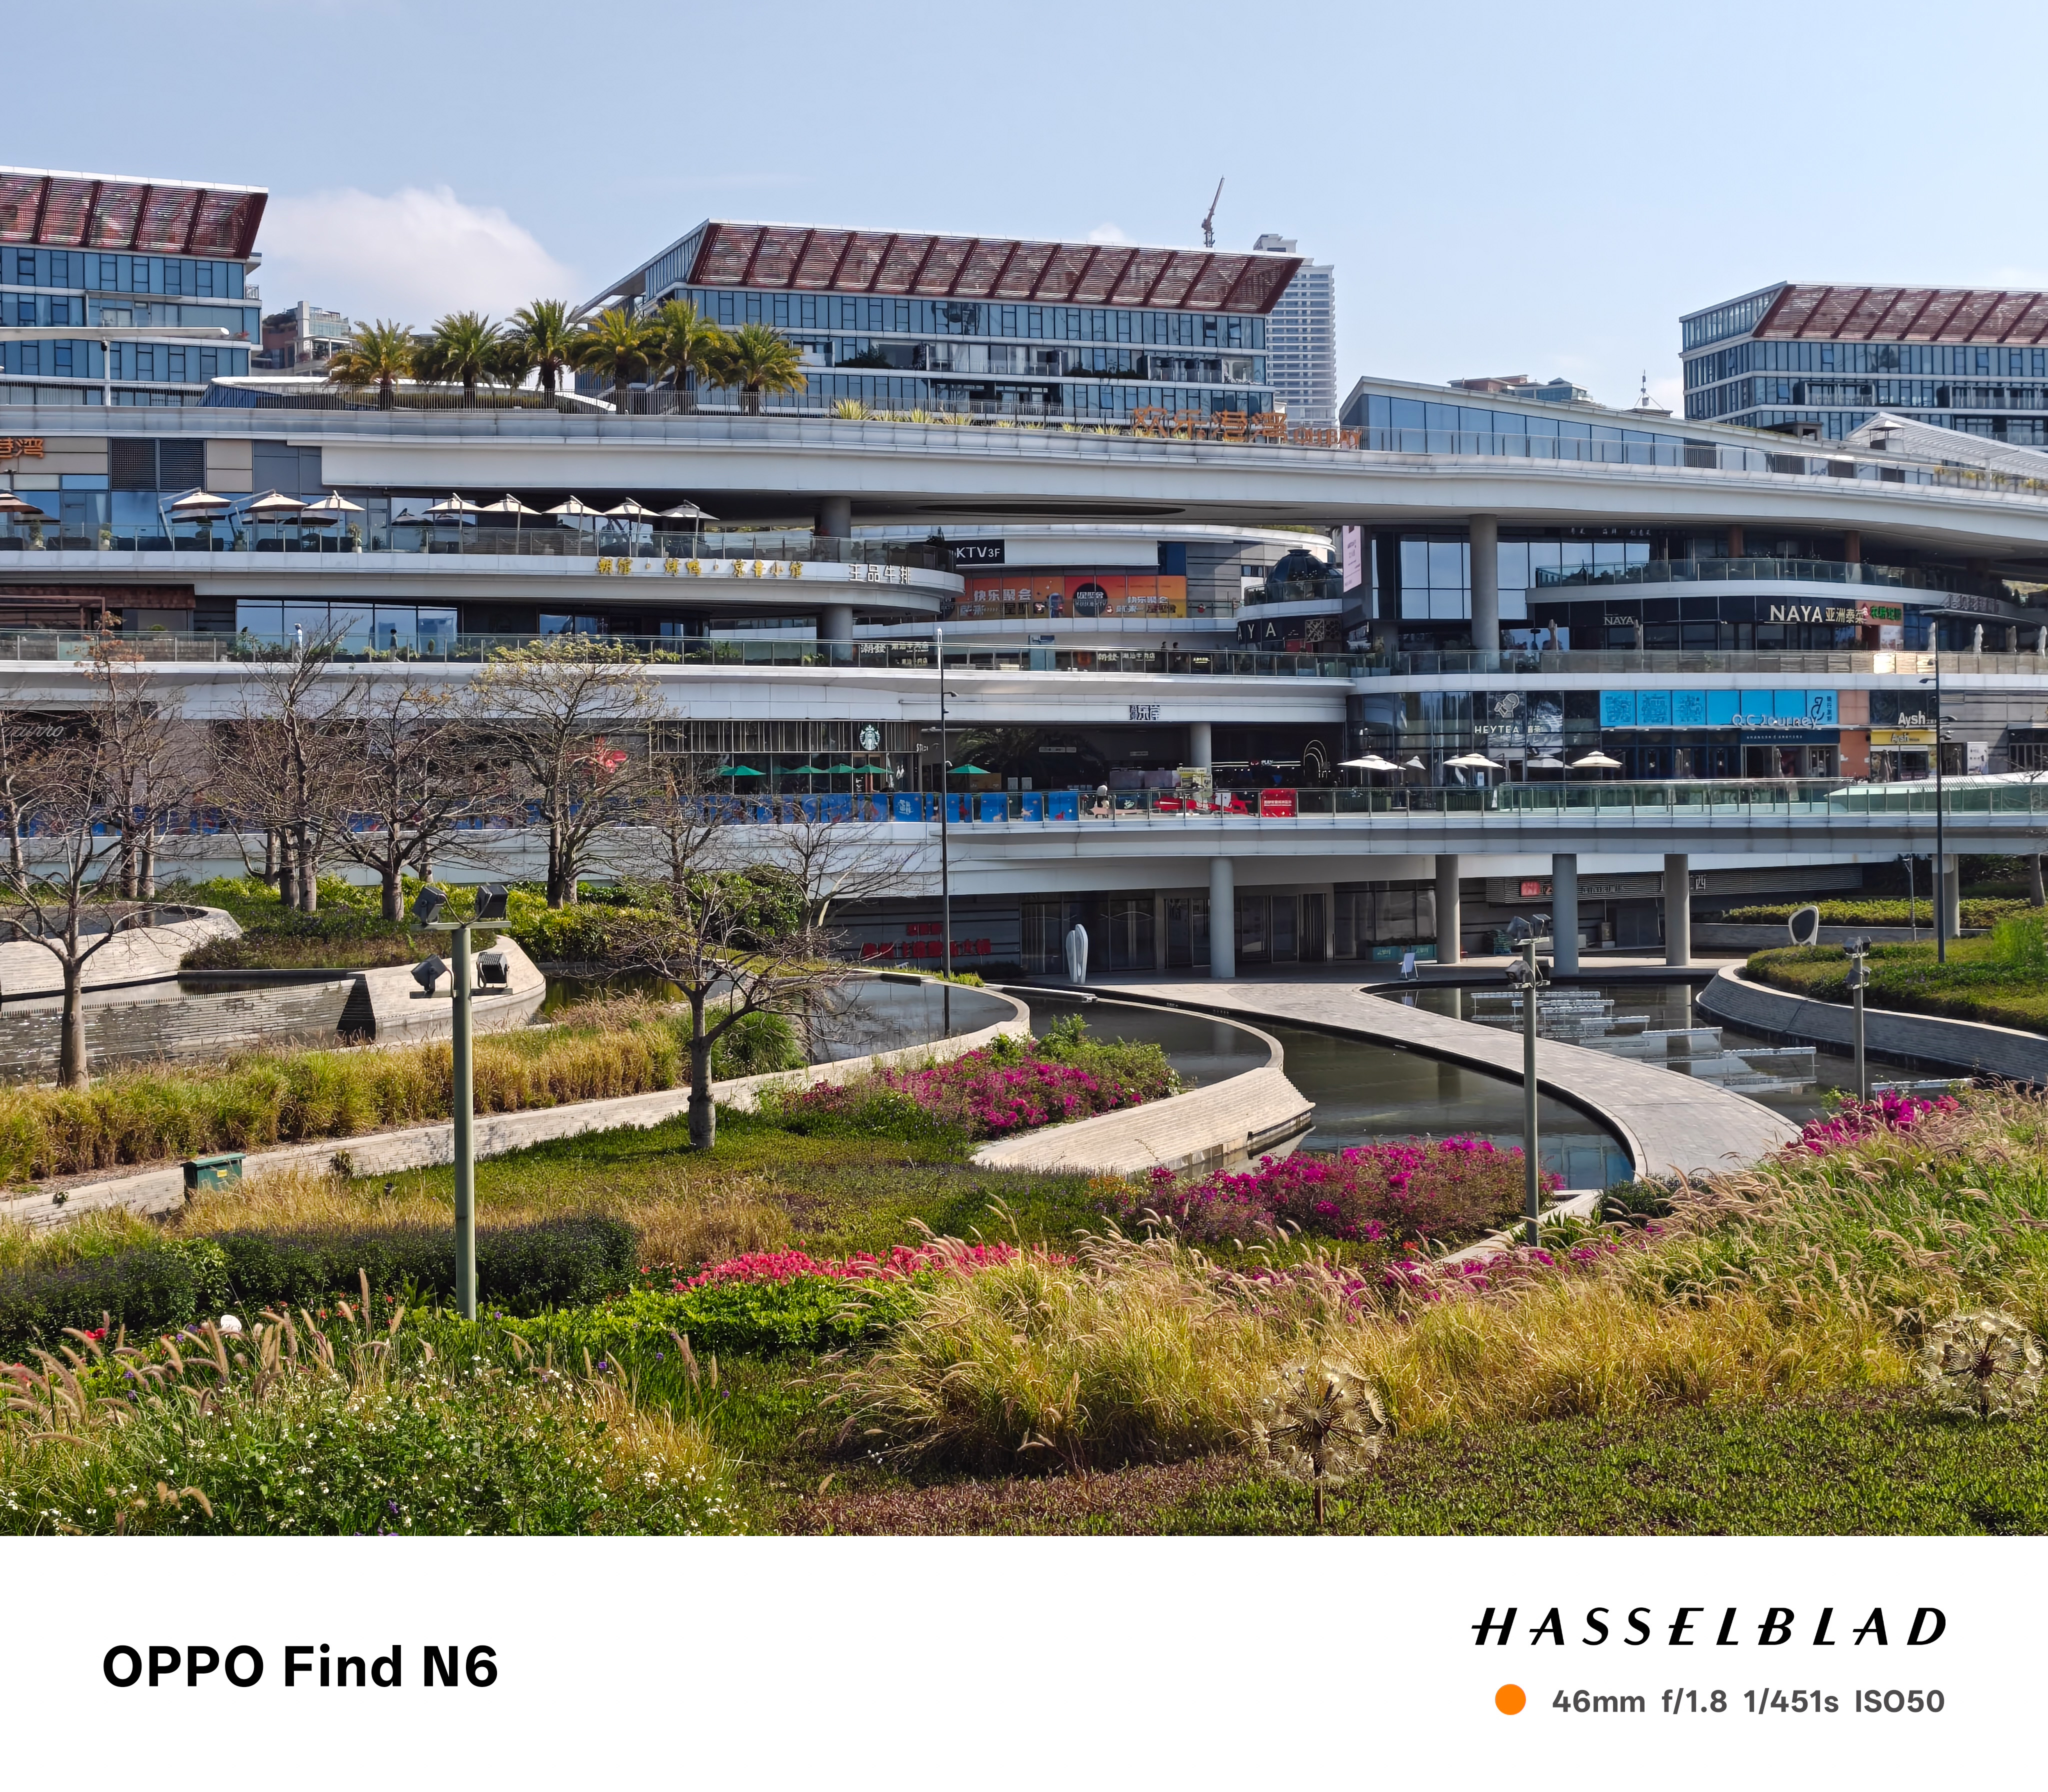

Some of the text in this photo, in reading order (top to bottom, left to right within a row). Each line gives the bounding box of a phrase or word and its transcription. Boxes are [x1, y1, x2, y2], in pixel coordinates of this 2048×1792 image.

[1133, 404, 1288, 443] 欢乐港湾
[849, 564, 910, 584] 王品牛排
[1604, 616, 1634, 625] NAYA
[1770, 604, 1823, 622] NAYA
[1760, 714, 1818, 730] Journey
[1898, 710, 1926, 728] Aysh
[1474, 725, 1520, 734] HEYTEA
